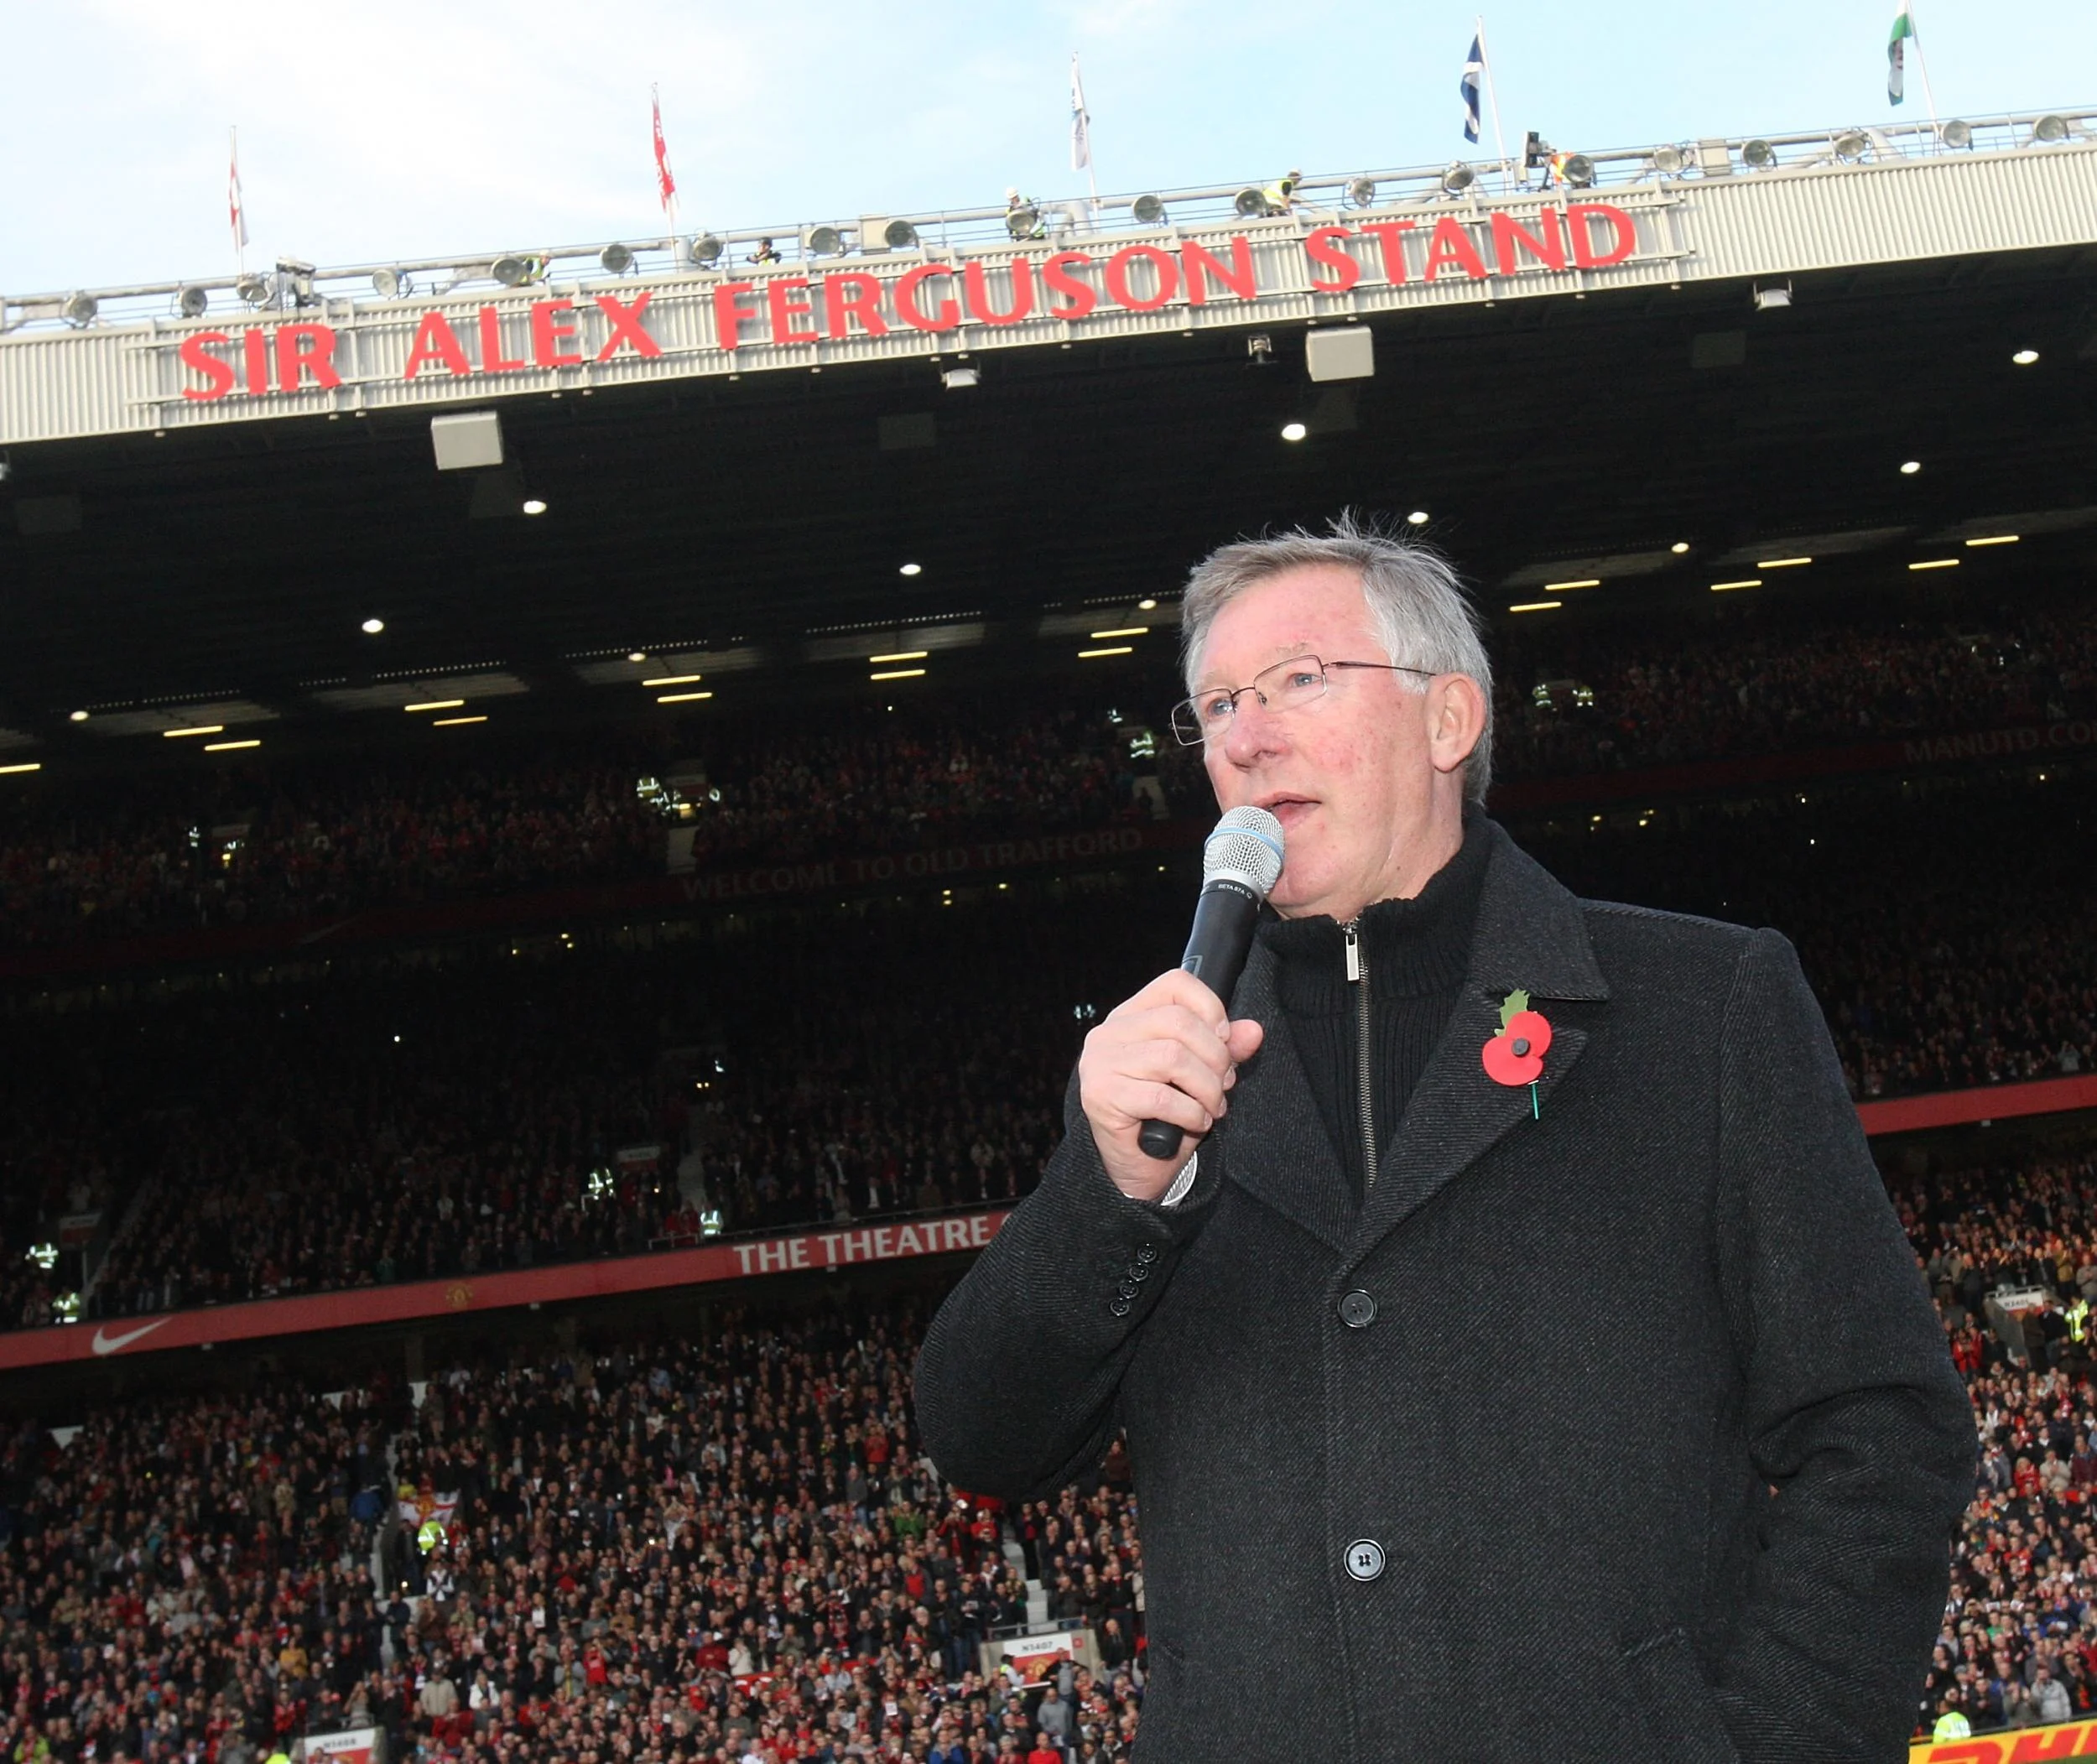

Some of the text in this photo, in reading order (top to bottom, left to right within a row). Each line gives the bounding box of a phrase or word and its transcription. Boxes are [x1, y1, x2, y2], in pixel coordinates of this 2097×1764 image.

[181, 205, 1636, 401] SIR ALEX FERGUSON STAND
[682, 827, 1143, 902] WELCOME TO OLD TRAFFORD
[733, 1215, 991, 1274] THE THEATRE
